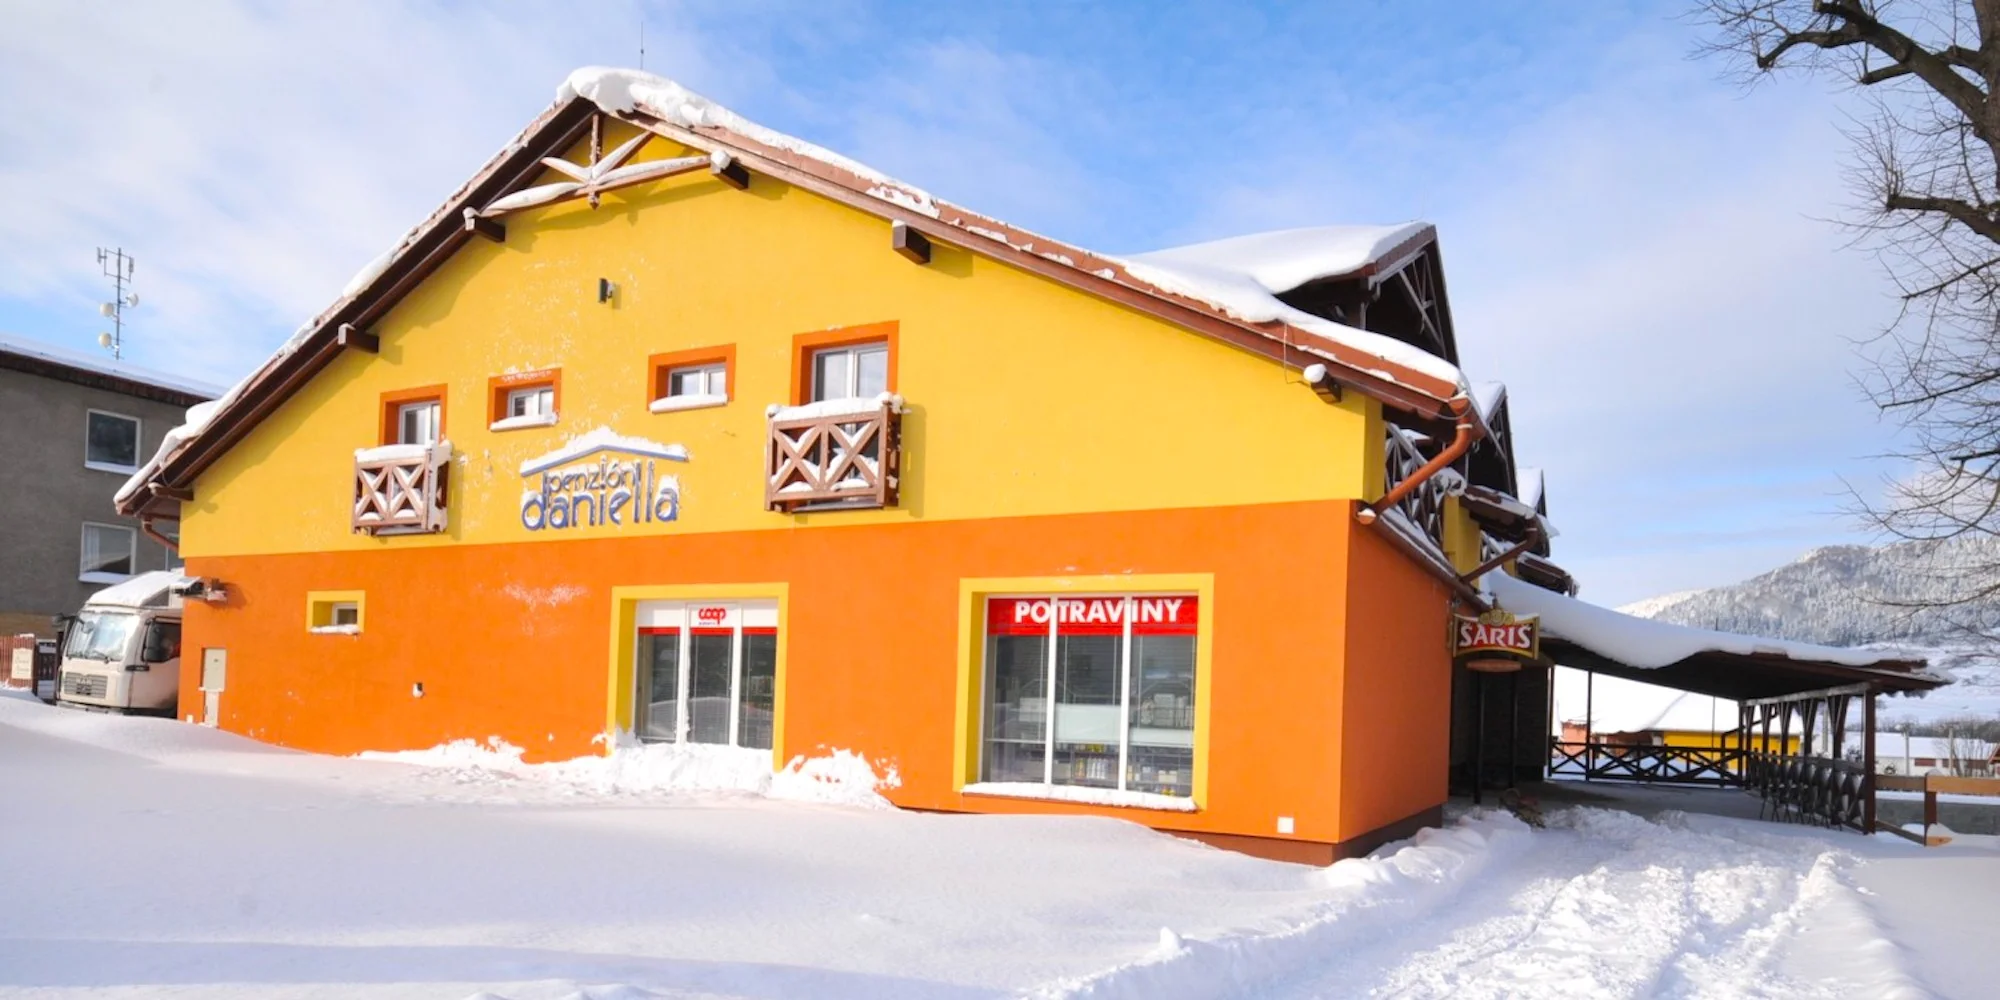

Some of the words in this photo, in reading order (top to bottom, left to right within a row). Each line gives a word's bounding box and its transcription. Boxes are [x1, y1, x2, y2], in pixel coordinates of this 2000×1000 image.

[547, 457, 636, 493] penzión
[522, 460, 678, 531] daniella
[698, 608, 726, 624] coop
[1015, 599, 1182, 623] POTRAVINY
